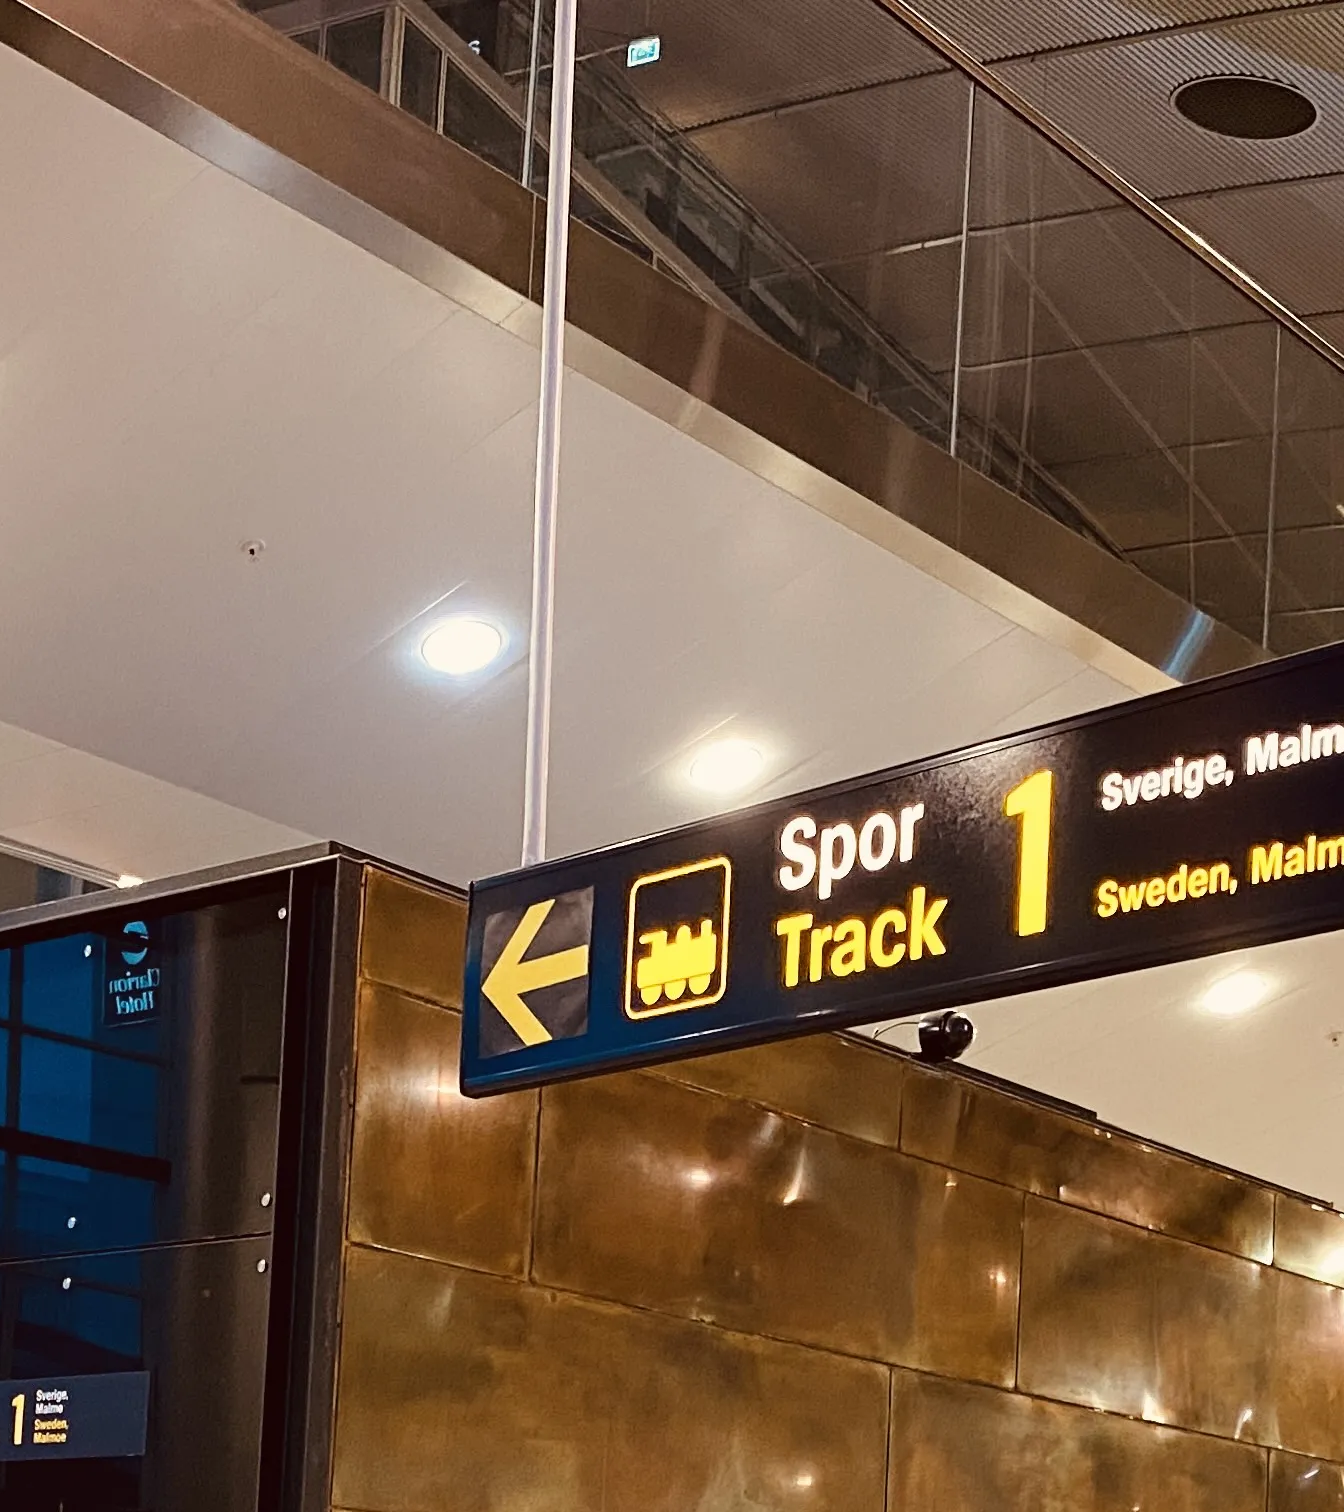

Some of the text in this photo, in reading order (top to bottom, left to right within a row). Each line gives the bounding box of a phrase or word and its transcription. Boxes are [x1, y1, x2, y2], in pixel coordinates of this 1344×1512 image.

[1101, 753, 1235, 812] Sverige,
[778, 802, 926, 901] Spor
[1004, 770, 1053, 938] 1
[1096, 862, 1239, 919] Sweden,
[775, 885, 949, 989] Track
[11, 1393, 26, 1445] 1
